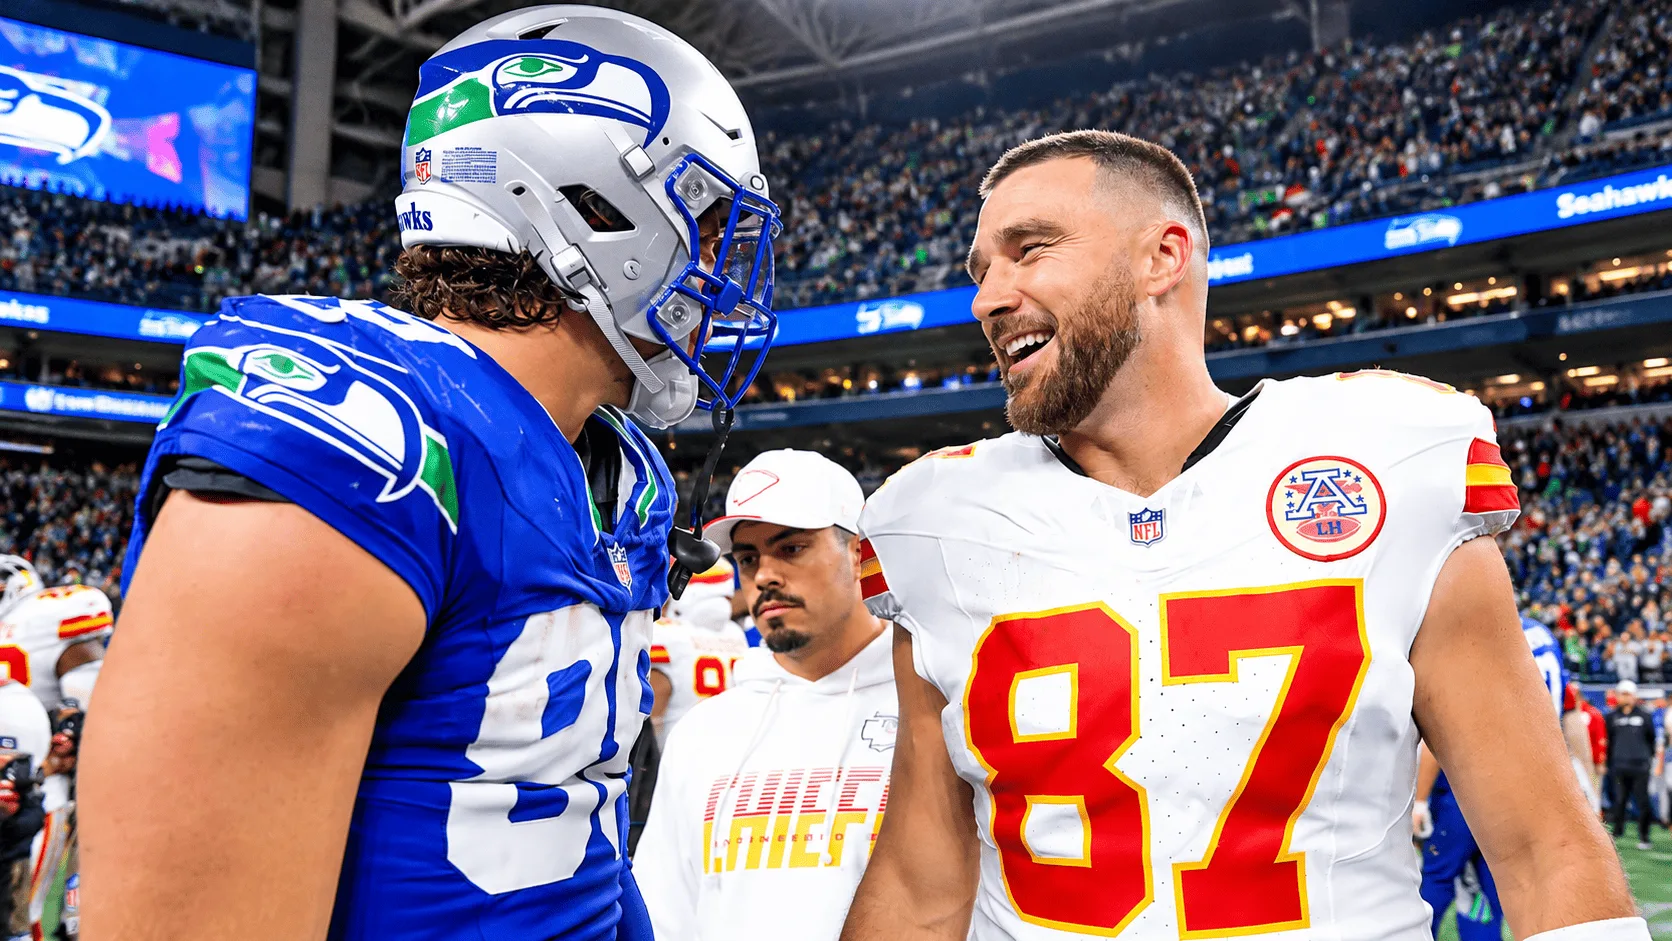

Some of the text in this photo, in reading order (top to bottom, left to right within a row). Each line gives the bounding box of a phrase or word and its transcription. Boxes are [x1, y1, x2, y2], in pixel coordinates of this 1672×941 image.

[1133, 522, 1161, 541] NFL
[1315, 520, 1343, 537] LH
[963, 578, 1372, 940] 87
